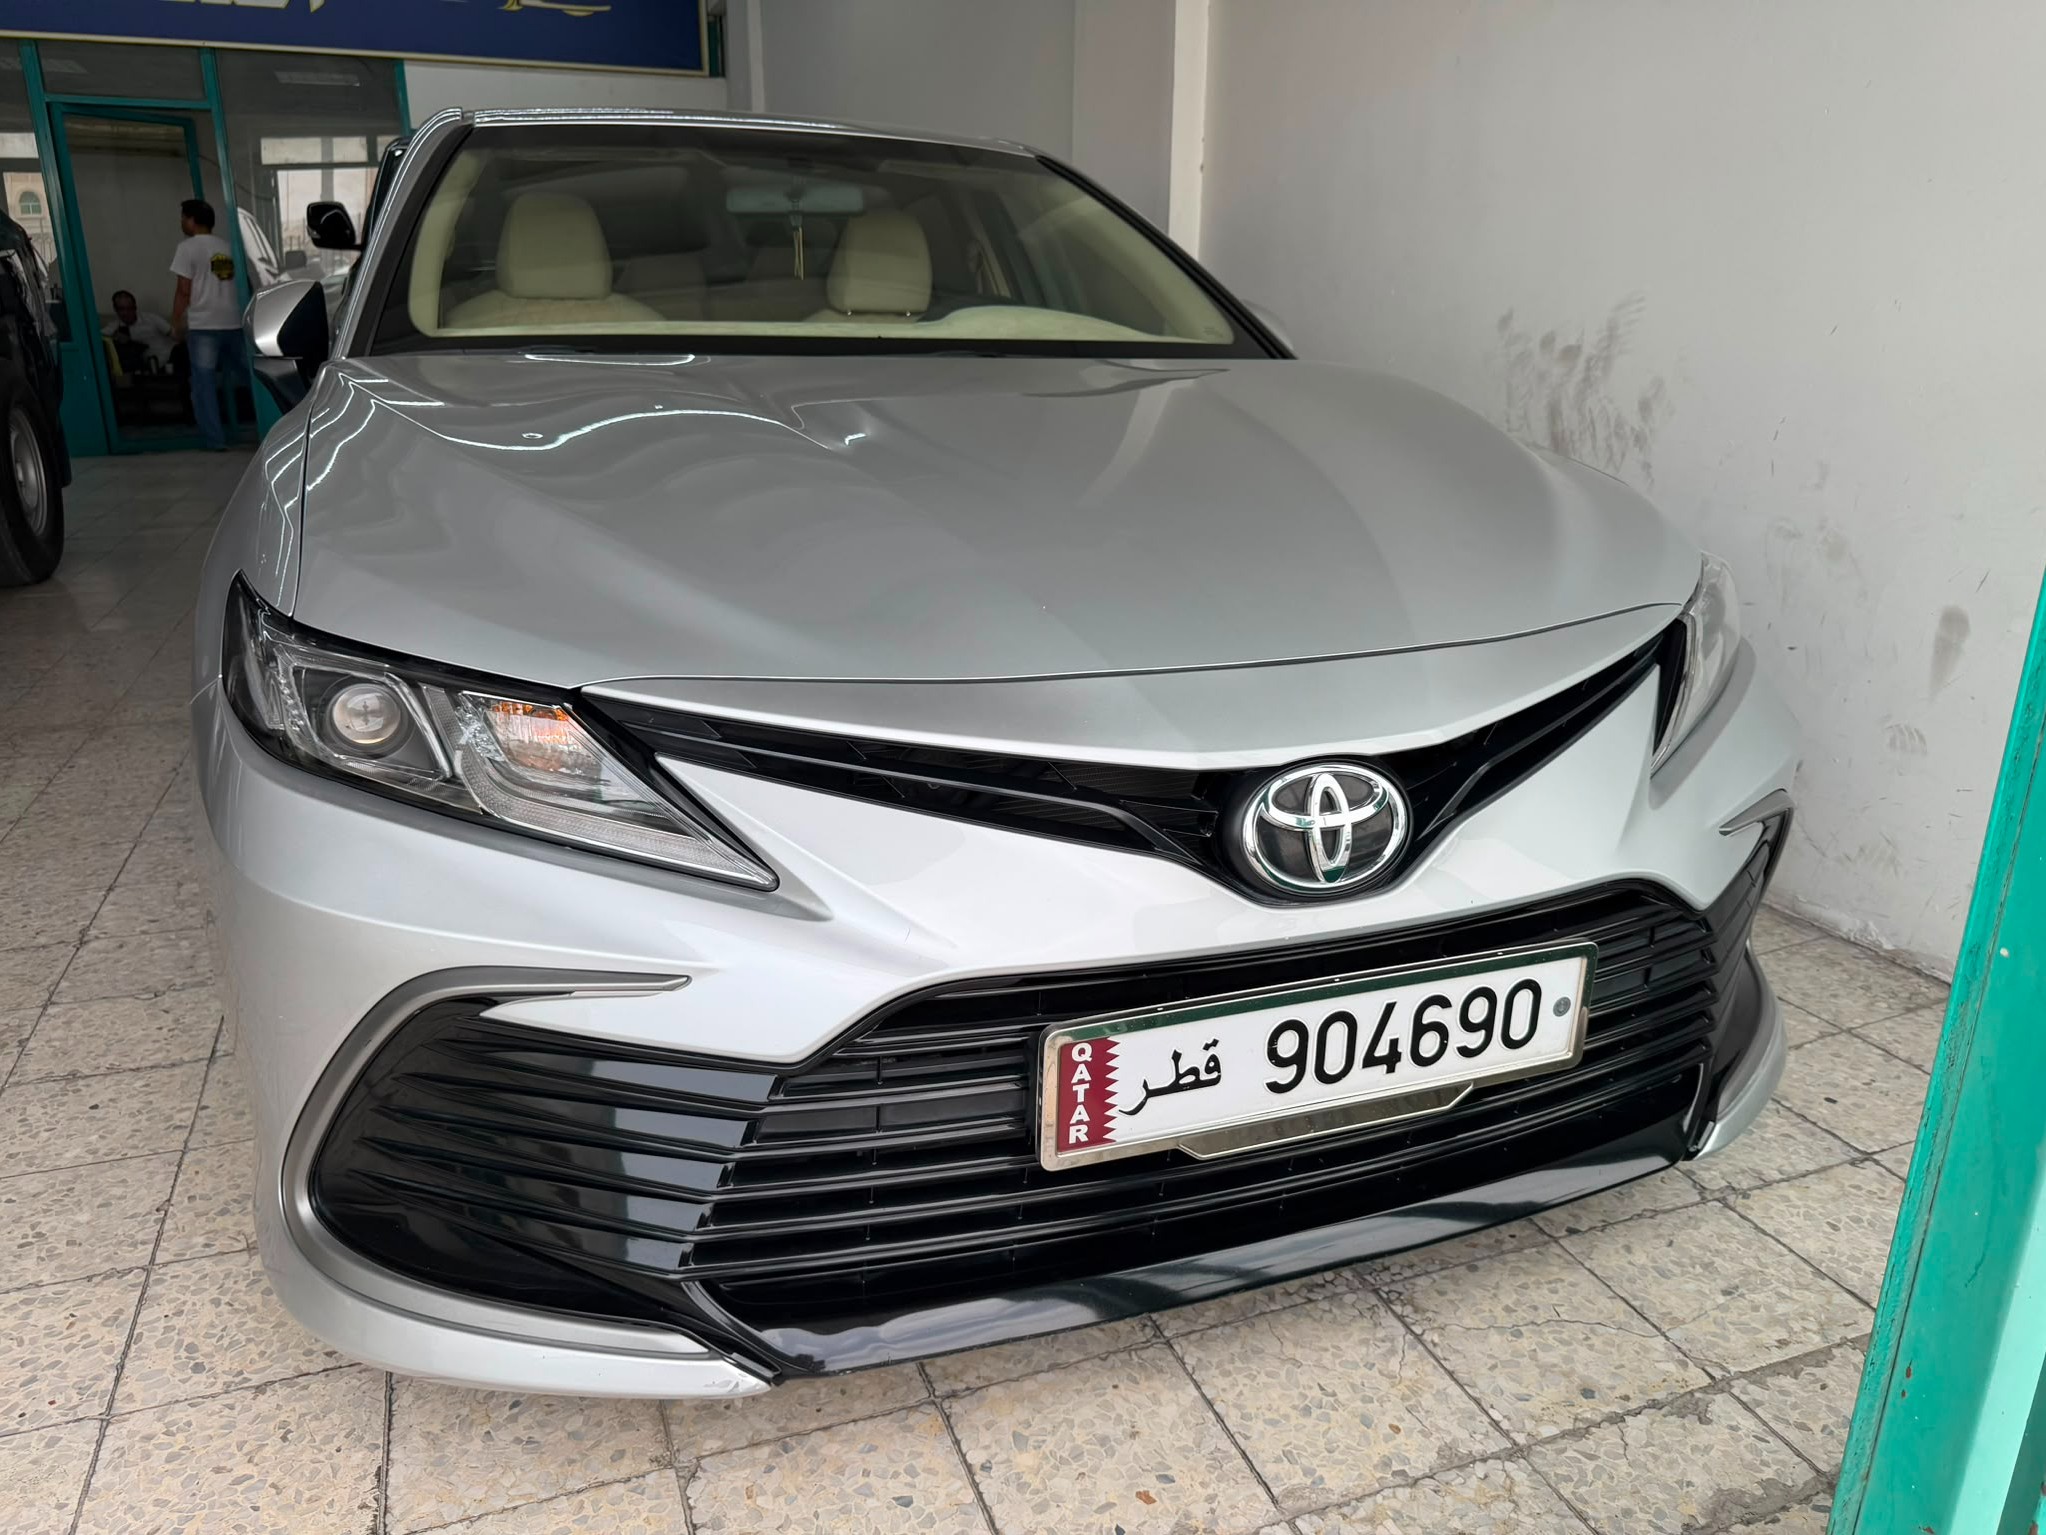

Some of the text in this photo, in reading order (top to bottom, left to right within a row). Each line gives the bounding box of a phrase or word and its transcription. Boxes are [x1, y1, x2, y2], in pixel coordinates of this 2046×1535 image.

[1068, 1041, 1092, 1146] QATAR
[1118, 978, 1542, 1116] قطر 904690
